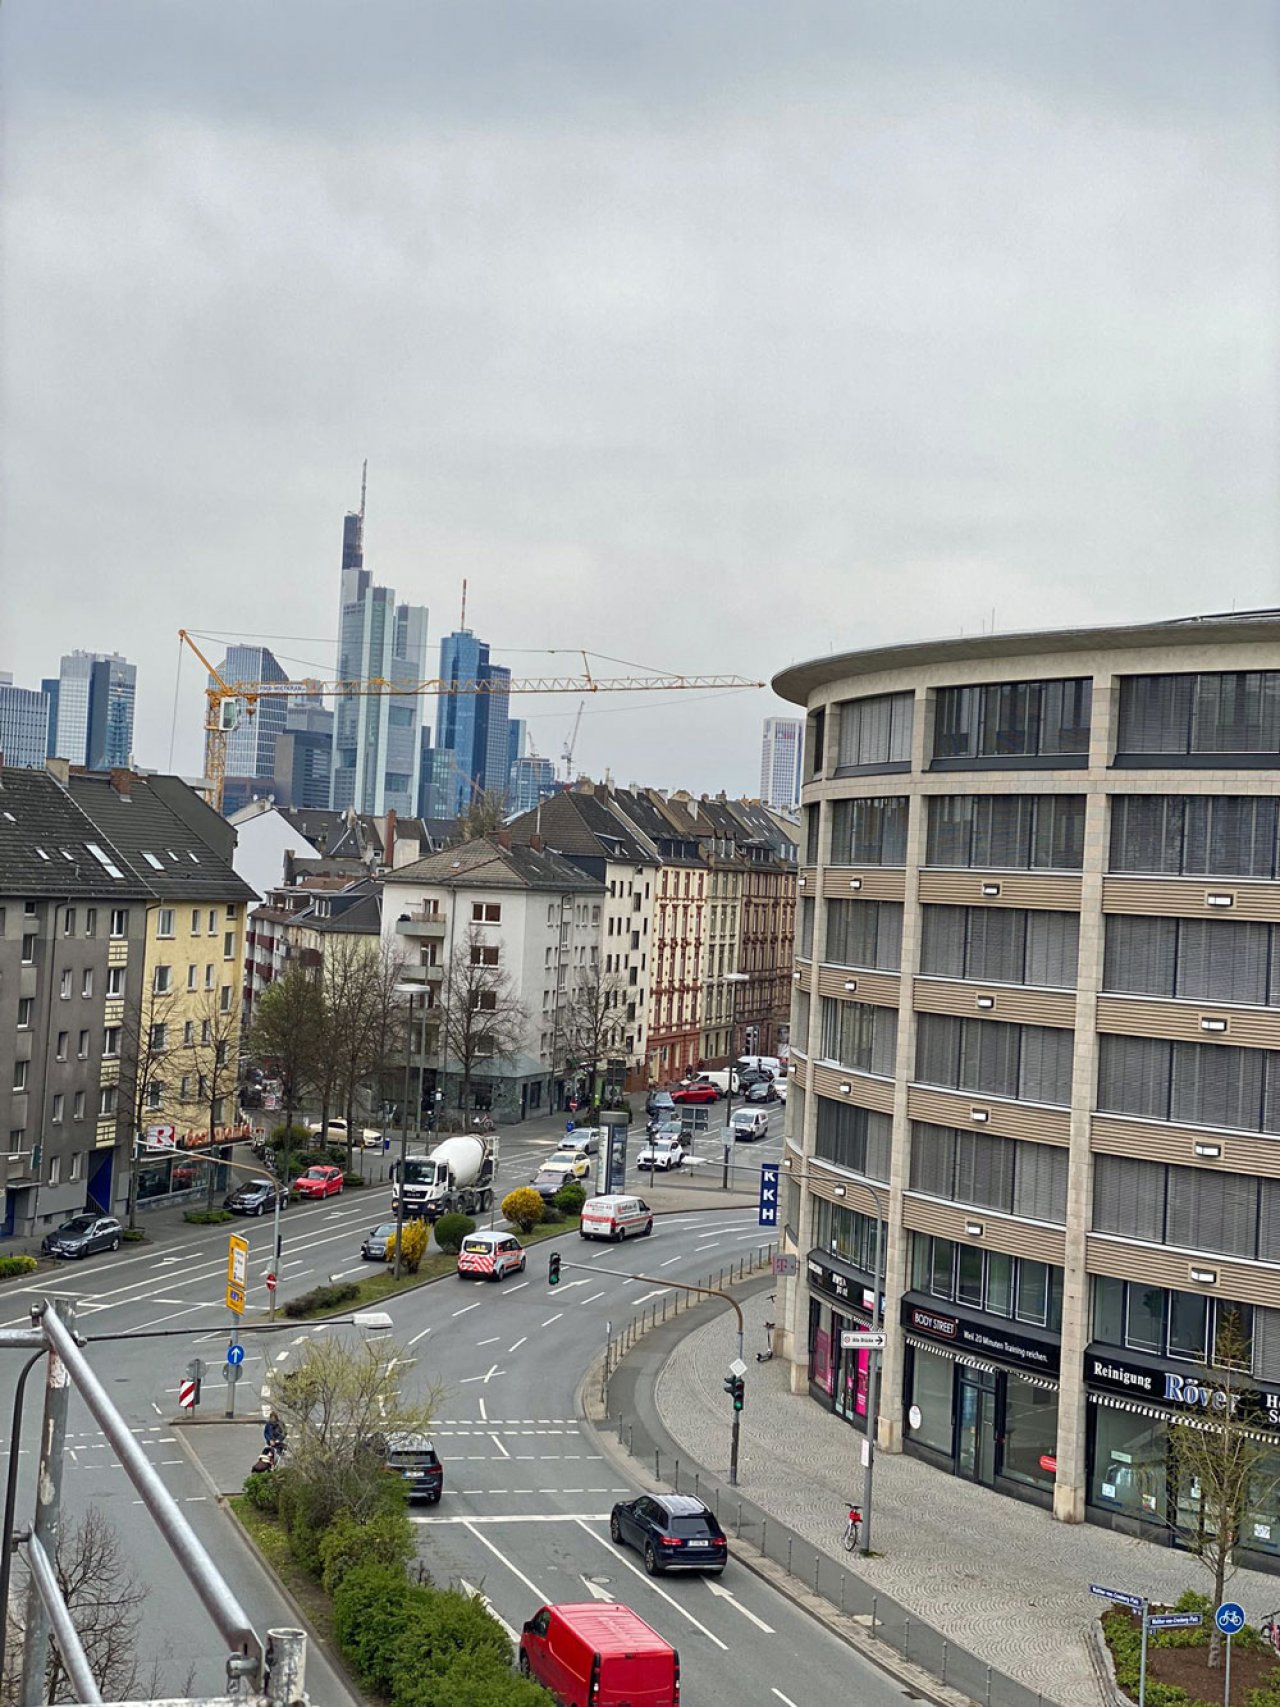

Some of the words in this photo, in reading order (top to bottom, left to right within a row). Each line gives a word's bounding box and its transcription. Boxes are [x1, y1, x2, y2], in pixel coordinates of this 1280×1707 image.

[762, 1171, 775, 1220] KKH
[914, 1313, 933, 1327] BODY
[932, 1318, 954, 1334] STREET
[974, 1332, 983, 1343] 20
[982, 1335, 1004, 1350] Minuten
[1004, 1341, 1025, 1358] Training
[1093, 1361, 1152, 1390] Reinigung
[1163, 1372, 1240, 1413] Röver
[1266, 1393, 1280, 1408] H
[1269, 1409, 1280, 1424] S
